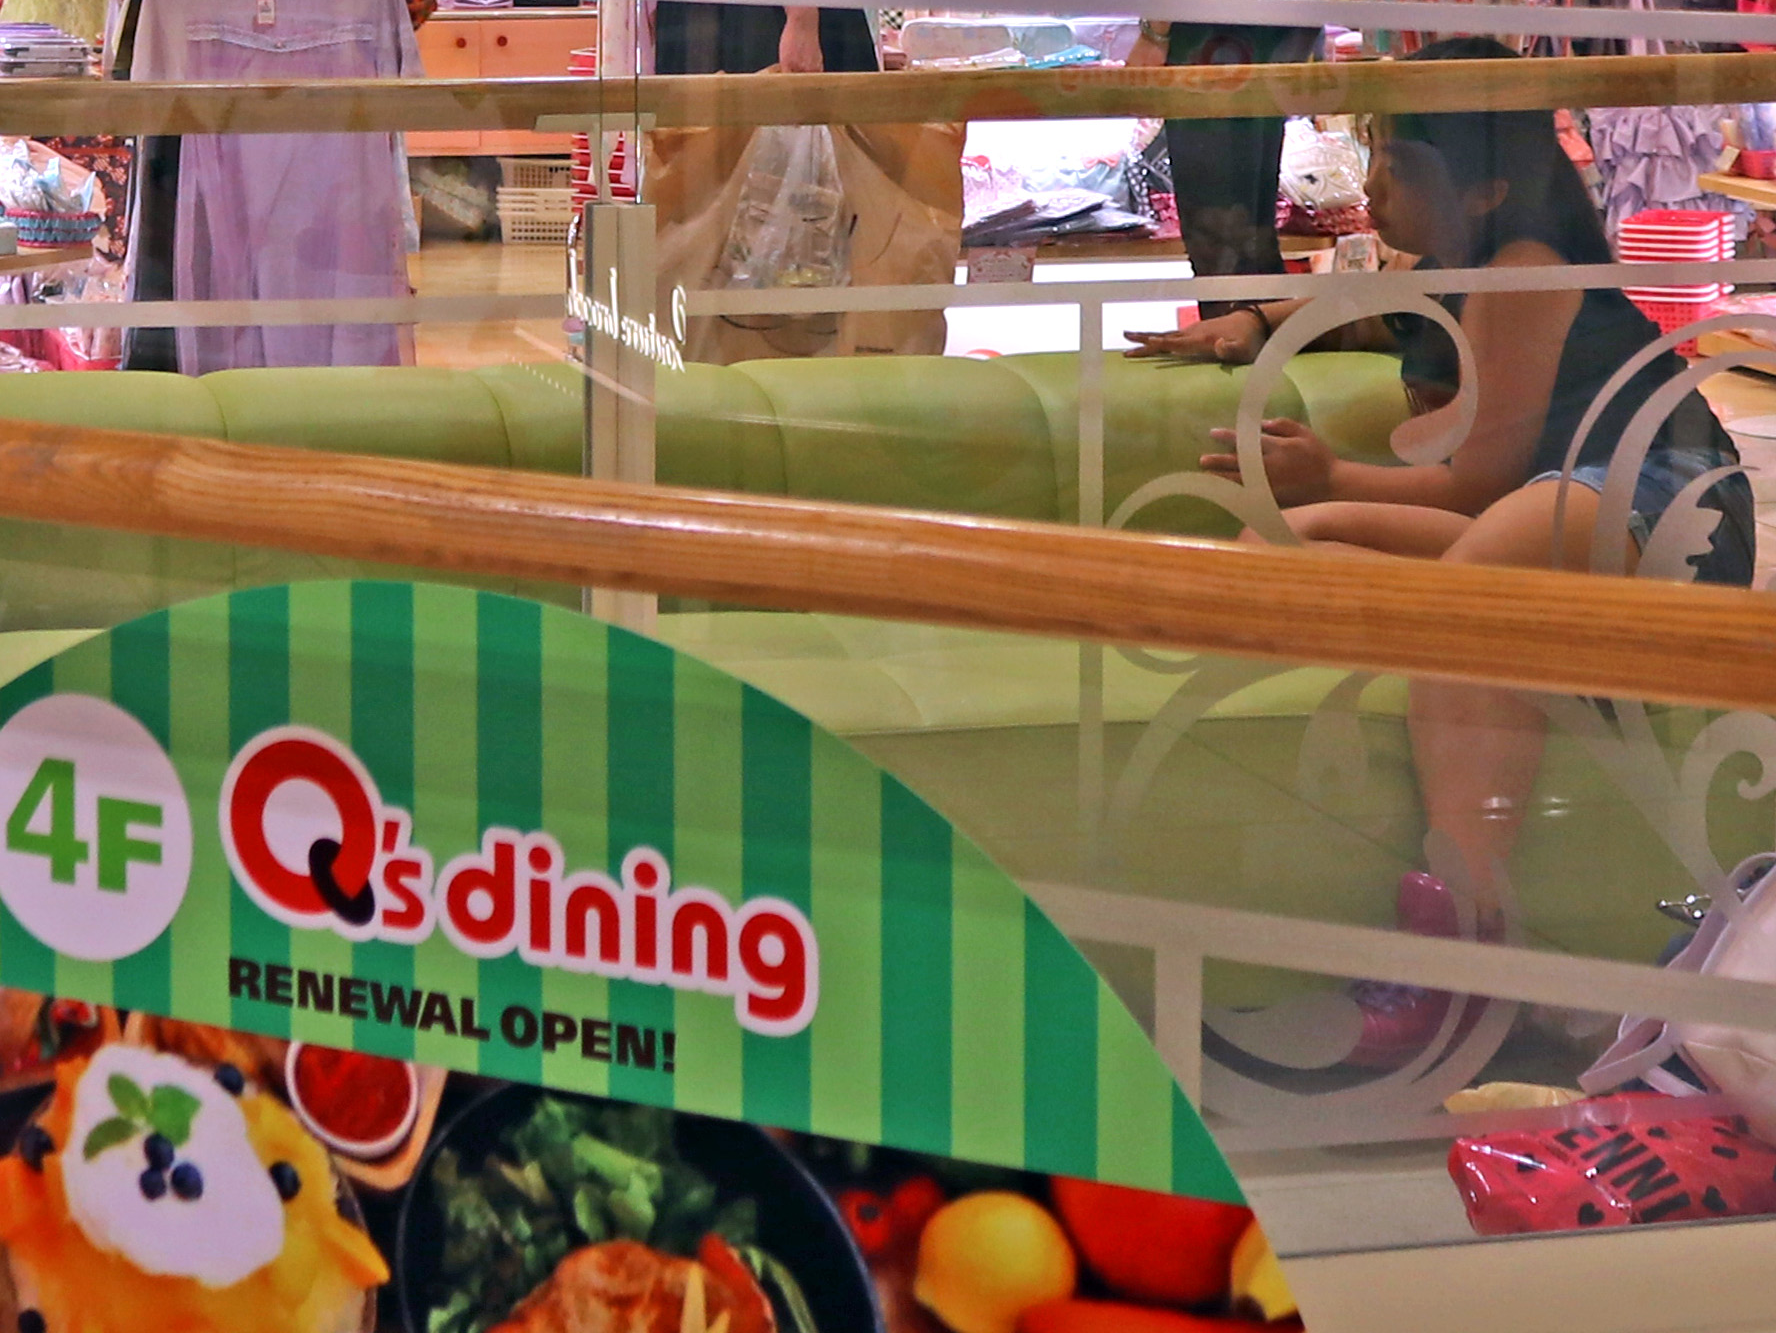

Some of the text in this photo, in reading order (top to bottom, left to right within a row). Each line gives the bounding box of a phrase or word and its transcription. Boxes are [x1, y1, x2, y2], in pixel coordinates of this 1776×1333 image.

[3, 735, 808, 1025] 4F Q's dining
[227, 957, 679, 1072] RENEWAL OPEN!
